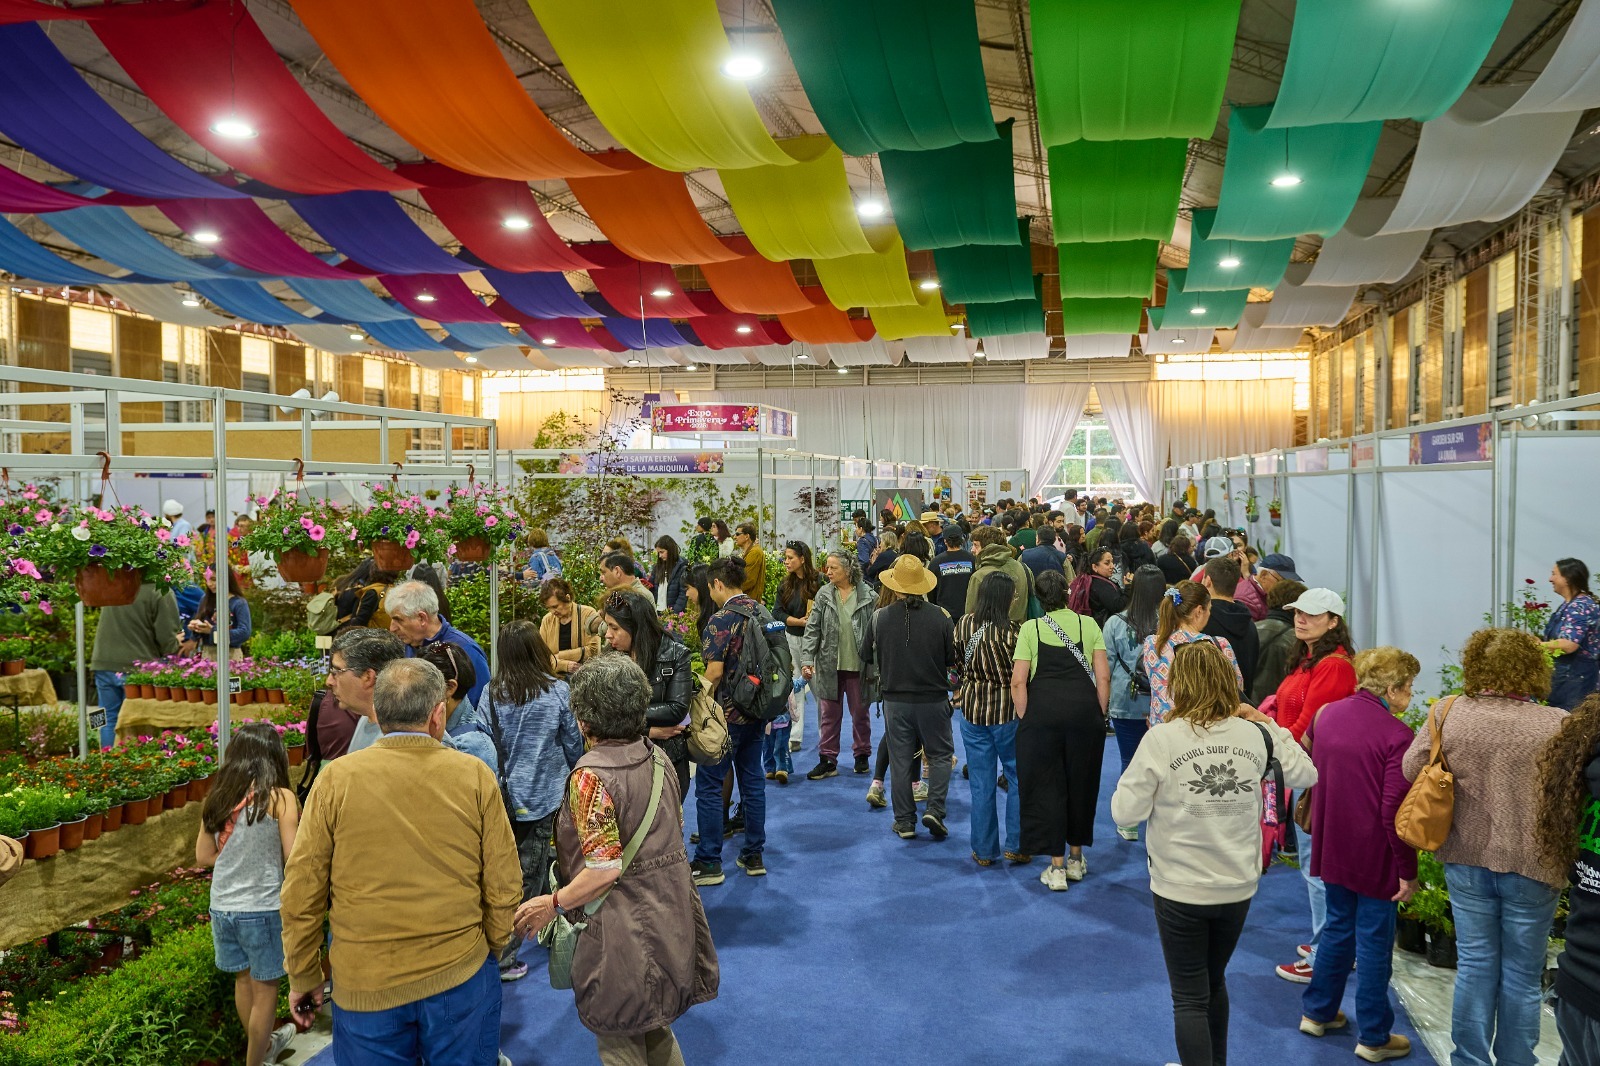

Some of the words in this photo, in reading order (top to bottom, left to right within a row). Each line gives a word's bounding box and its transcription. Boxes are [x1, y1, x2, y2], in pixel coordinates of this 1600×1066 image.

[687, 409, 711, 418] Expo
[675, 415, 727, 425] Primavera
[630, 455, 653, 463] SANTA
[655, 455, 678, 463] ELENA
[648, 464, 689, 473] MARIQUINA
[1169, 748, 1204, 771] RIPCURL
[1206, 745, 1230, 754] SURF
